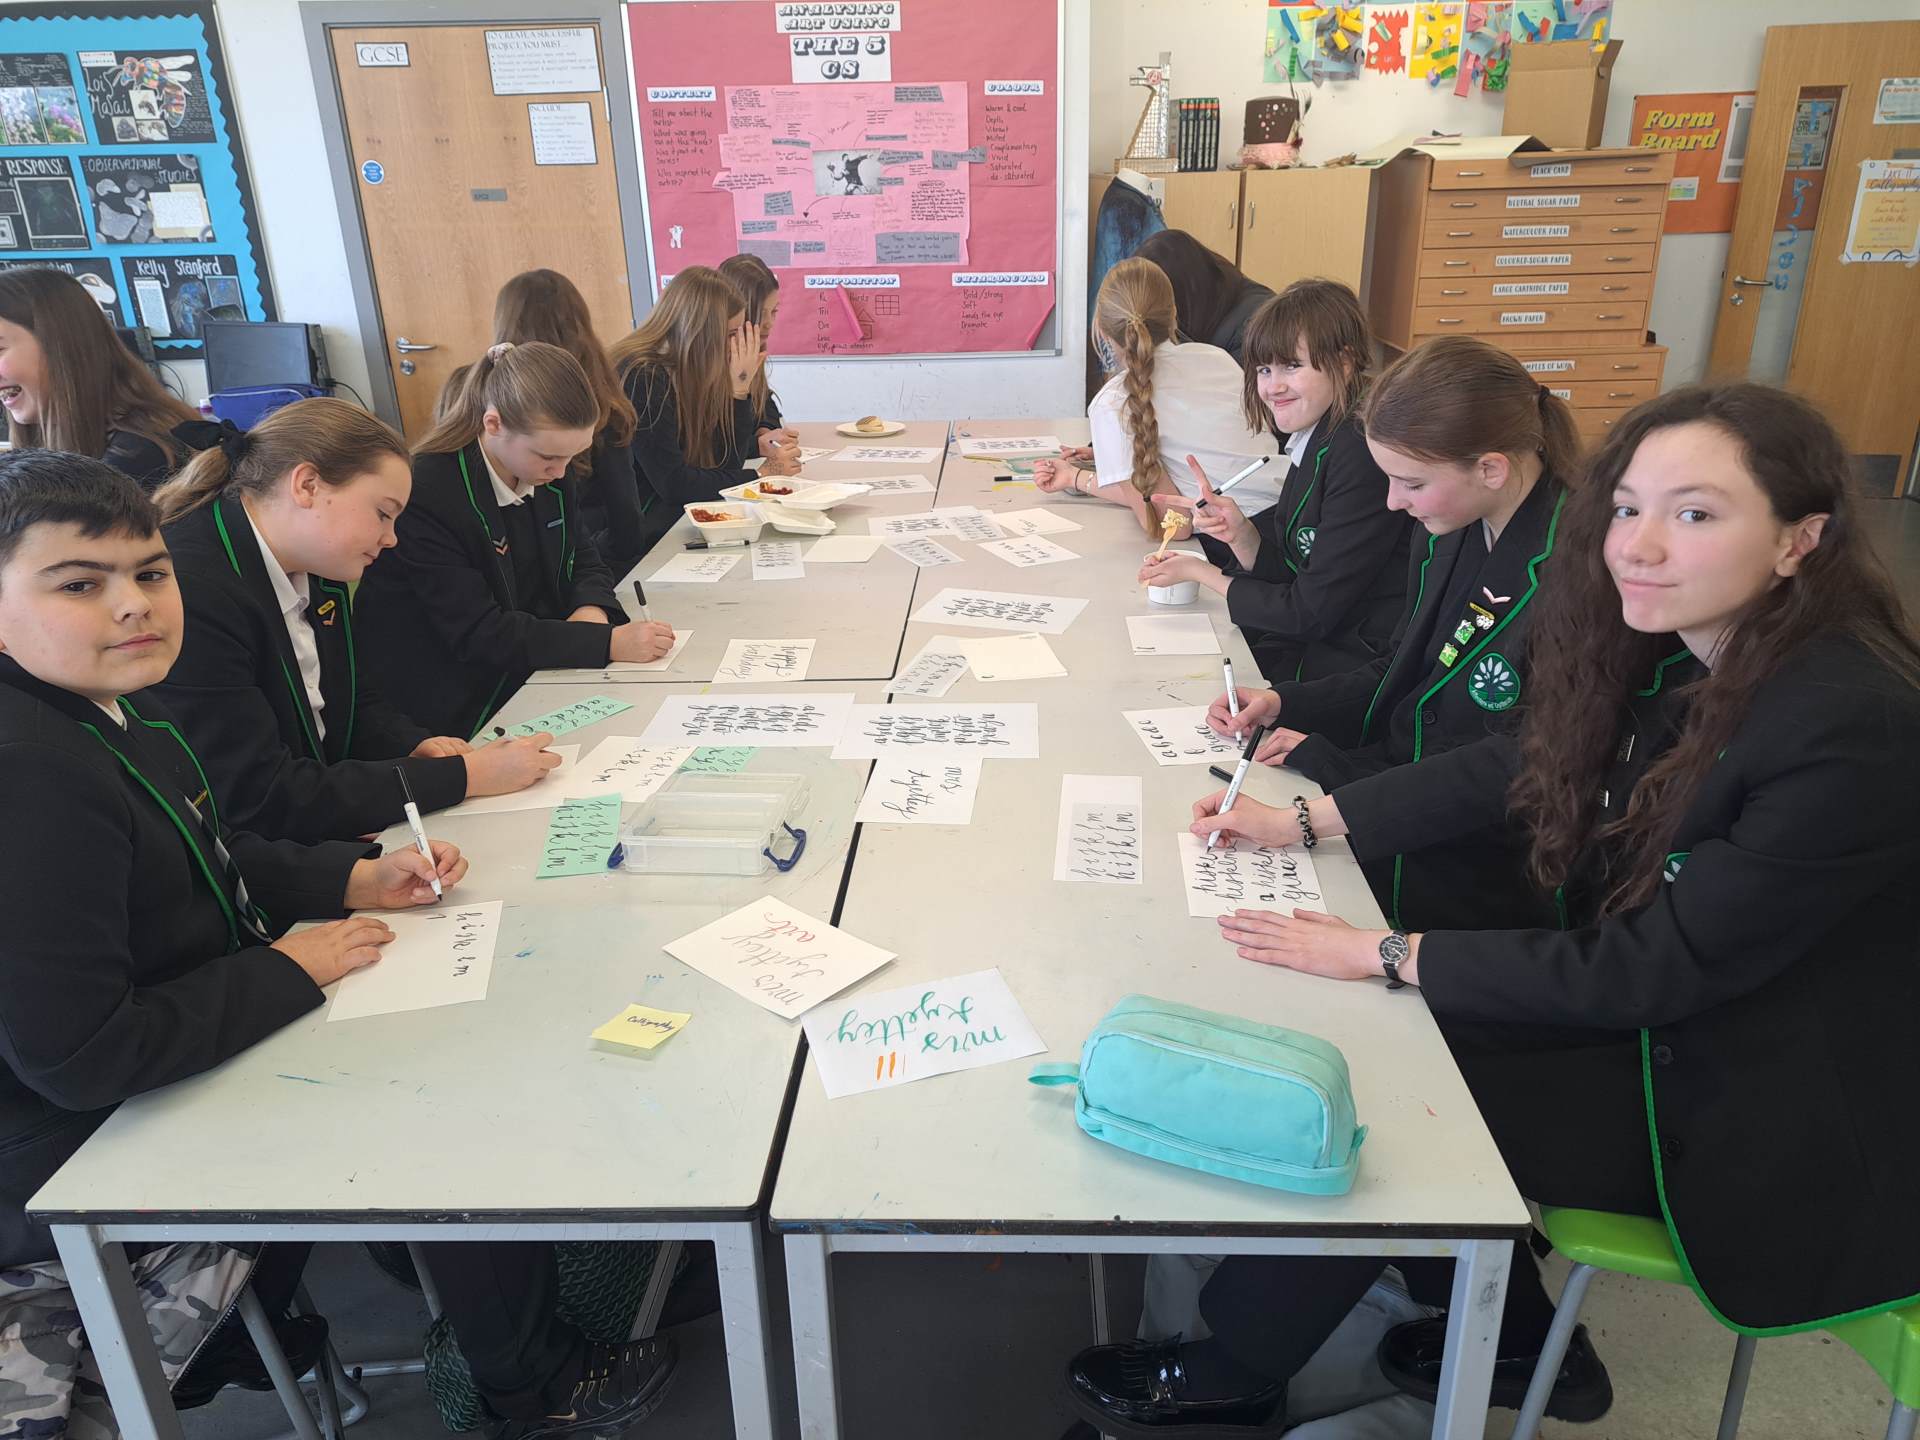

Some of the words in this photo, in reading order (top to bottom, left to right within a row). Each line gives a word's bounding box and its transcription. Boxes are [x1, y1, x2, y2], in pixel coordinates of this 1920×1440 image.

[779, 3, 894, 16] ANALYSING
[785, 19, 825, 30] ART
[829, 17, 890, 30] USING
[793, 36, 860, 56] THE
[865, 36, 886, 55] 5
[360, 46, 404, 62] GCSE
[821, 60, 860, 79] CS
[651, 89, 713, 99] CONTEXT
[988, 84, 1040, 92] COLOUR
[652, 108, 664, 118] Tell
[701, 107, 712, 118] the
[1642, 109, 1716, 131] Form
[1640, 128, 1721, 151] Board
[6, 159, 67, 175] RESPONSE
[88, 158, 162, 172] OBSERVATIONAL
[1532, 166, 1551, 176] BLACK
[1553, 166, 1569, 175] CARD
[1507, 199, 1535, 208] NEUTRAL
[1537, 198, 1557, 207] SUGAR
[1558, 197, 1579, 206] PAPER
[1548, 226, 1568, 236] PAPER
[1550, 255, 1570, 264] PAPER
[136, 259, 170, 288] Kelly
[175, 255, 223, 279] Stanford
[955, 274, 1045, 283] CHIAROSCURO
[1494, 284, 1513, 294] LARGE
[1514, 284, 1547, 293] CARTRIDGE
[1548, 283, 1568, 292] PAPER
[1502, 314, 1522, 324] BROWN
[1524, 313, 1543, 323] PAPER
[626, 1015, 676, 1034] Calligraphy
[921, 1025, 1007, 1053] mrs
